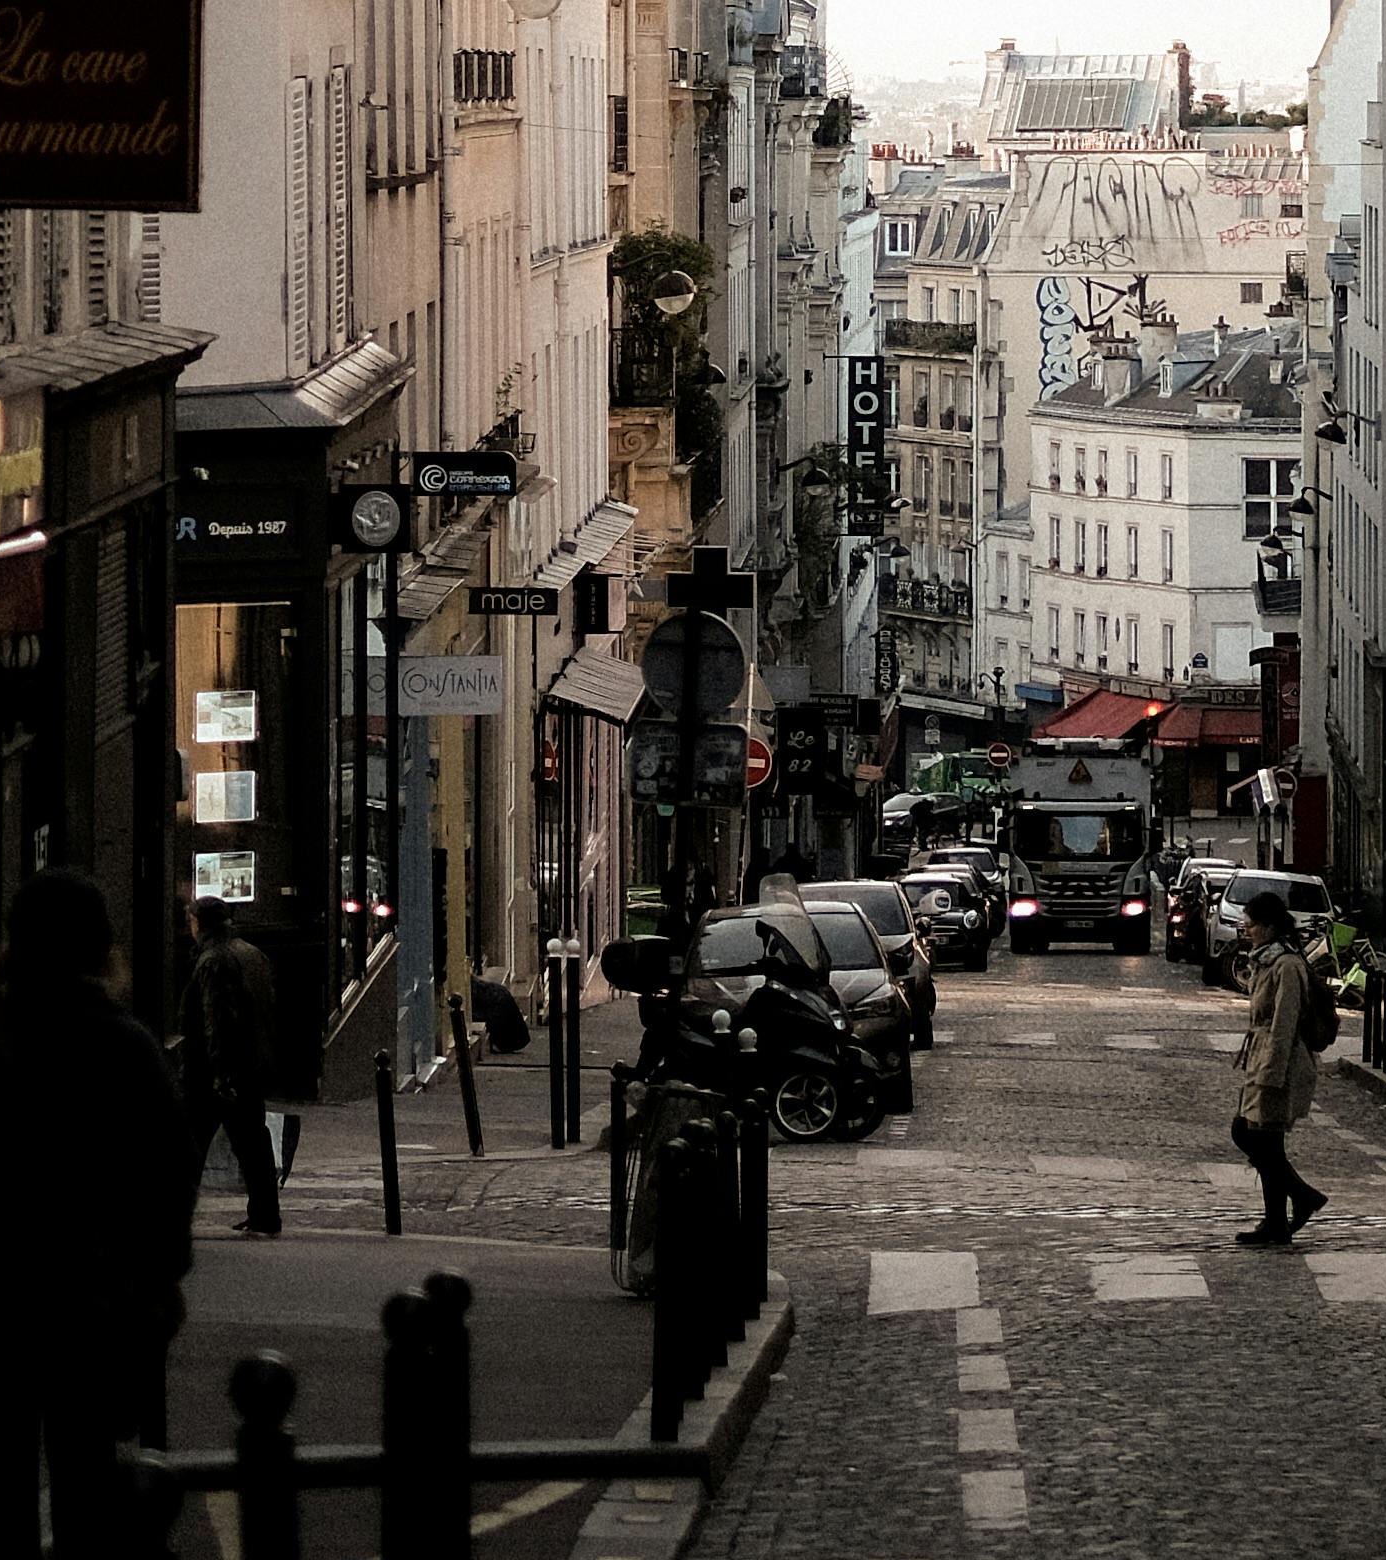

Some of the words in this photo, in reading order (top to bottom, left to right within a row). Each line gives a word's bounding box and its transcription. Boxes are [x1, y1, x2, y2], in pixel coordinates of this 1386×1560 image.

[62, 48, 148, 84] cave
[853, 361, 880, 504] HOTEL
[208, 522, 254, 540] Depuis
[257, 520, 288, 535] 1987
[481, 589, 546, 613] maje
[787, 730, 815, 750] Le
[788, 758, 812, 773] 82
